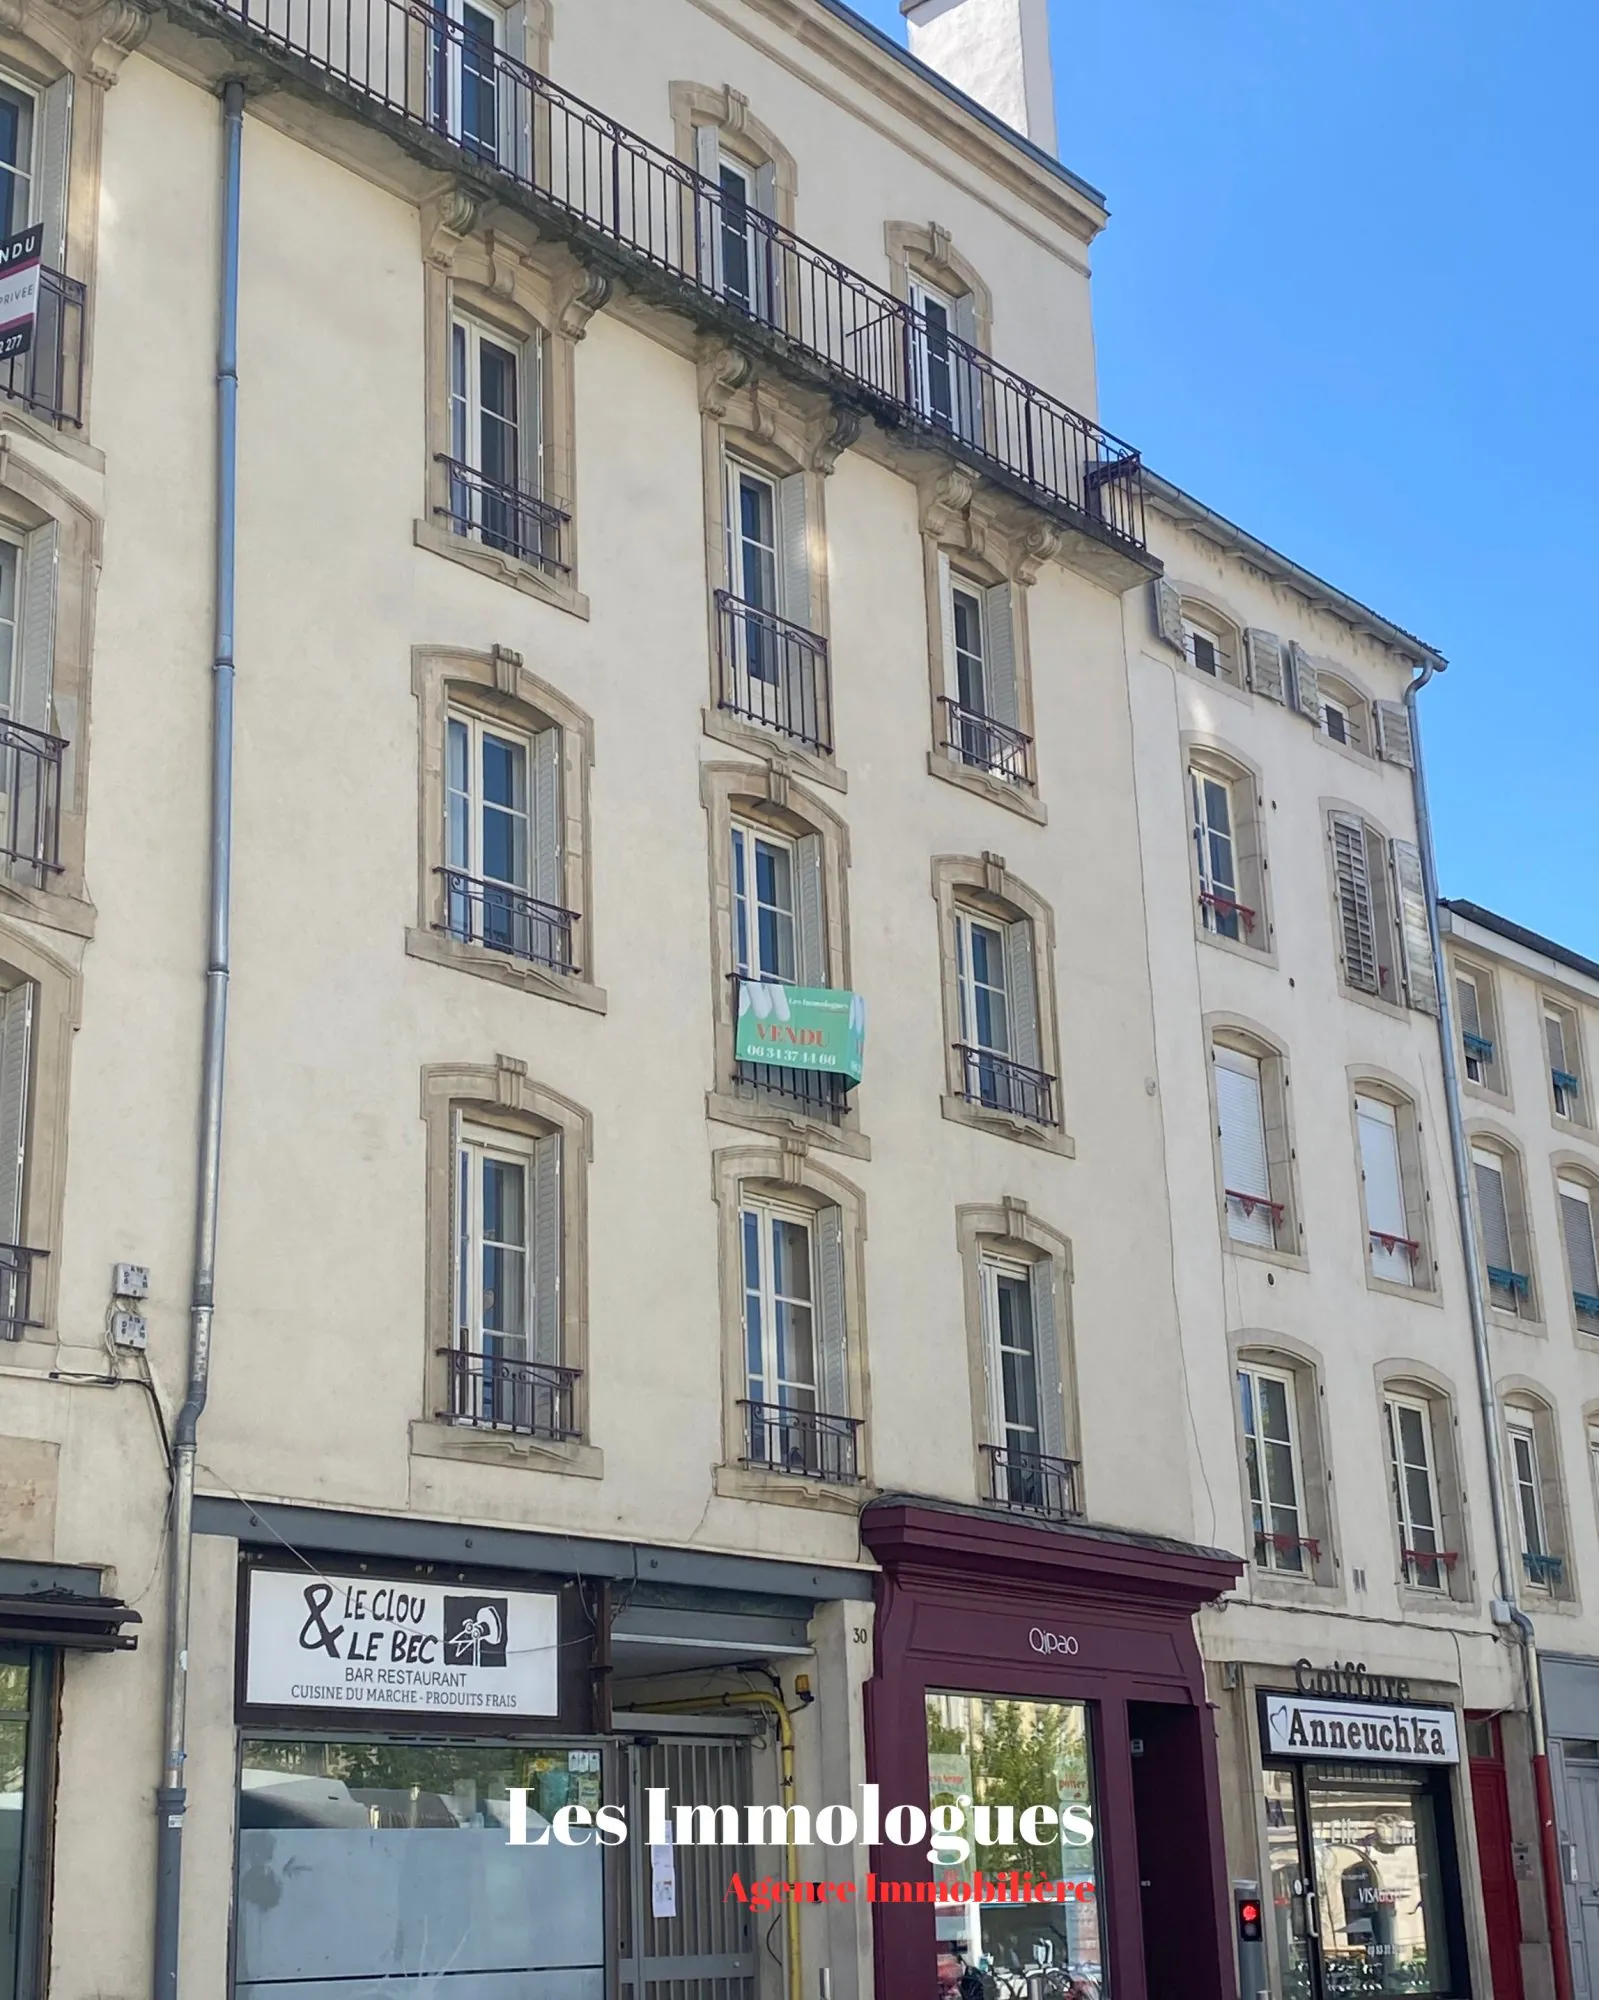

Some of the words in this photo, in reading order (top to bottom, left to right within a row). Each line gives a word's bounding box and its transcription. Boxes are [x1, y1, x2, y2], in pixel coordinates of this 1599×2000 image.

[5, 334, 22, 352] 277
[756, 1023, 830, 1047] VENDU
[344, 1585, 367, 1620] LE
[372, 1588, 426, 1624] CLOU
[300, 1583, 345, 1659] &
[347, 1631, 383, 1662] LE
[391, 1630, 439, 1664] BEC
[853, 1628, 868, 1645] 30
[1029, 1627, 1079, 1655] Qipao
[345, 1667, 373, 1683] BAR
[377, 1669, 467, 1687] RESTAURANT
[1295, 1658, 1410, 1703] Coiffure
[291, 1684, 343, 1700] CUISINE
[346, 1687, 363, 1701] DU
[366, 1688, 417, 1703] MARCHE
[425, 1691, 484, 1706] PRODUITS
[485, 1694, 517, 1708] FRAIS
[1288, 1708, 1446, 1755] Anneuchka
